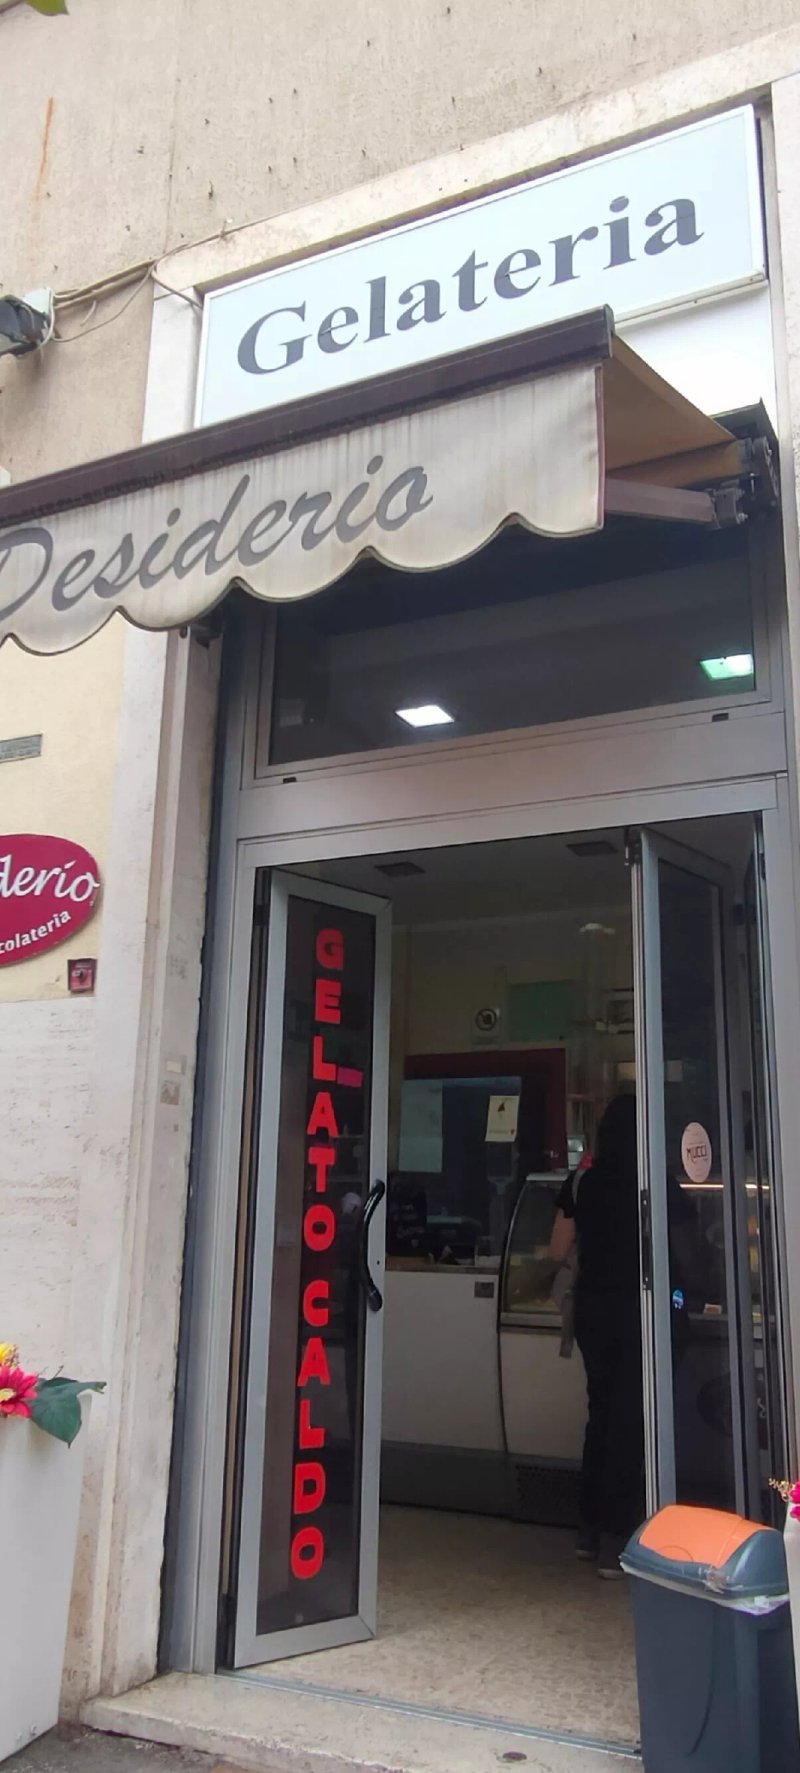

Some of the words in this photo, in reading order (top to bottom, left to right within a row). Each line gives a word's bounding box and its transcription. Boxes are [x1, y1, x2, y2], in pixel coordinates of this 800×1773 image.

[236, 195, 705, 376] Gelateria
[0, 455, 433, 622] Desiderio
[303, 927, 344, 1251] GELATO
[290, 1279, 331, 1580] CALDO
